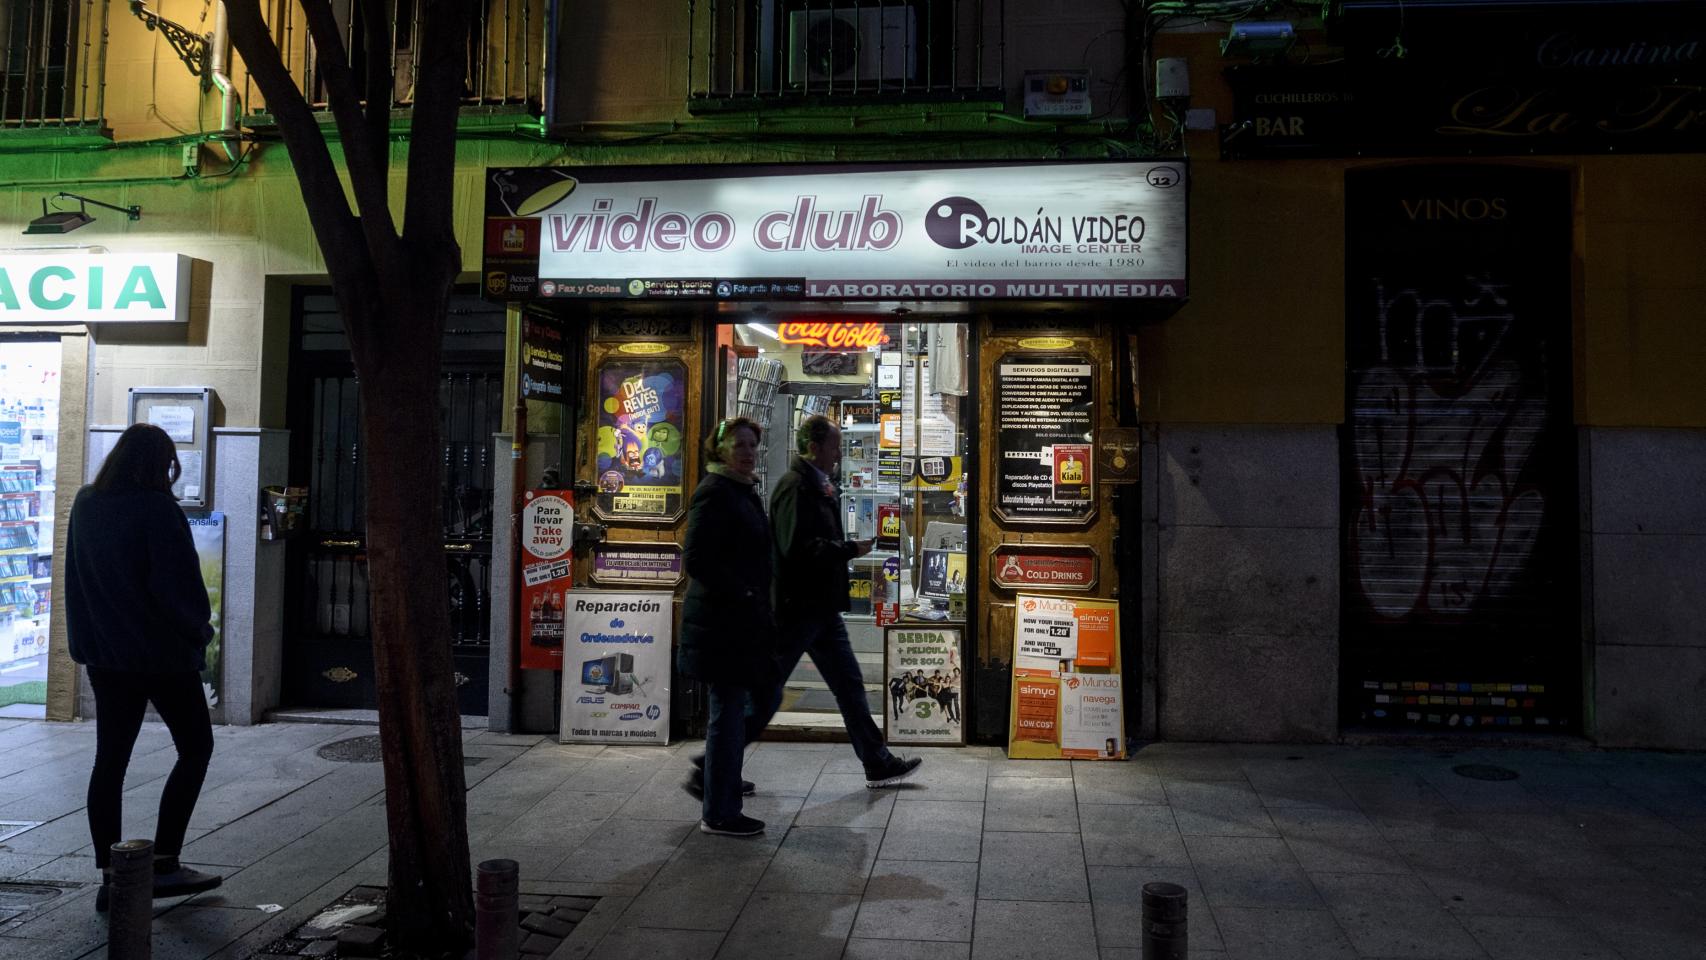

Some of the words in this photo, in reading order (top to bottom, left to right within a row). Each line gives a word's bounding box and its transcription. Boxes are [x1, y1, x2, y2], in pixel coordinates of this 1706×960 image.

[1536, 31, 1700, 69] Cantina
[1255, 92, 1339, 104] CUCHILLEROS
[1255, 116, 1305, 137] BAR
[1152, 176, 1170, 186] 12
[1399, 198, 1508, 220] VINOS
[548, 197, 736, 252] video
[753, 194, 904, 252] club
[960, 207, 1062, 244] ROLDÁN
[1072, 215, 1146, 244] VIDEO
[1021, 245, 1072, 254] IMAGE
[1077, 245, 1141, 254] CENTER
[946, 259, 958, 268] El
[963, 259, 996, 268] video
[1001, 259, 1019, 268] del
[1024, 259, 1062, 268] barrio
[1066, 259, 1101, 268] desde
[1107, 257, 1145, 268] 1980
[509, 274, 536, 283] Access
[509, 283, 529, 292] Point
[558, 284, 576, 293] Fax
[578, 285, 585, 294] y
[586, 283, 621, 295] Copias
[644, 280, 680, 290] Servicio
[810, 284, 996, 298] LABORATORIO
[1006, 283, 1177, 297] MULTIMEDIA
[622, 378, 652, 398] DEL
[843, 404, 874, 415] Mundo
[1004, 473, 1032, 483] Reparación
[1061, 471, 1082, 482] Kiala
[537, 506, 560, 515] Para
[533, 515, 564, 524] llevar
[534, 526, 562, 536] Take
[532, 536, 563, 547] away
[1026, 570, 1050, 580] COLD
[1051, 570, 1084, 581] DRINKS
[575, 599, 661, 615] Reparación
[1039, 599, 1074, 611] Mundo
[609, 618, 625, 628] de
[1053, 619, 1074, 627] DRINKS
[1079, 614, 1109, 624] simyo
[580, 632, 654, 644] Ordenadores
[897, 632, 946, 643] BEBIDA
[906, 646, 949, 654] PELICULA
[900, 657, 918, 666] POR
[919, 657, 945, 666] SOLO
[1082, 677, 1119, 688] Mundo
[1020, 685, 1056, 698] simyo
[575, 696, 605, 704] ASUS
[1083, 695, 1116, 705] navega
[610, 703, 641, 711] COMPAQ
[1019, 719, 1035, 728] LOW
[1036, 721, 1055, 729] COST
[571, 727, 590, 737] Todas
[599, 729, 623, 738] marcas
[623, 730, 629, 738] y
[629, 729, 657, 738] modelos
